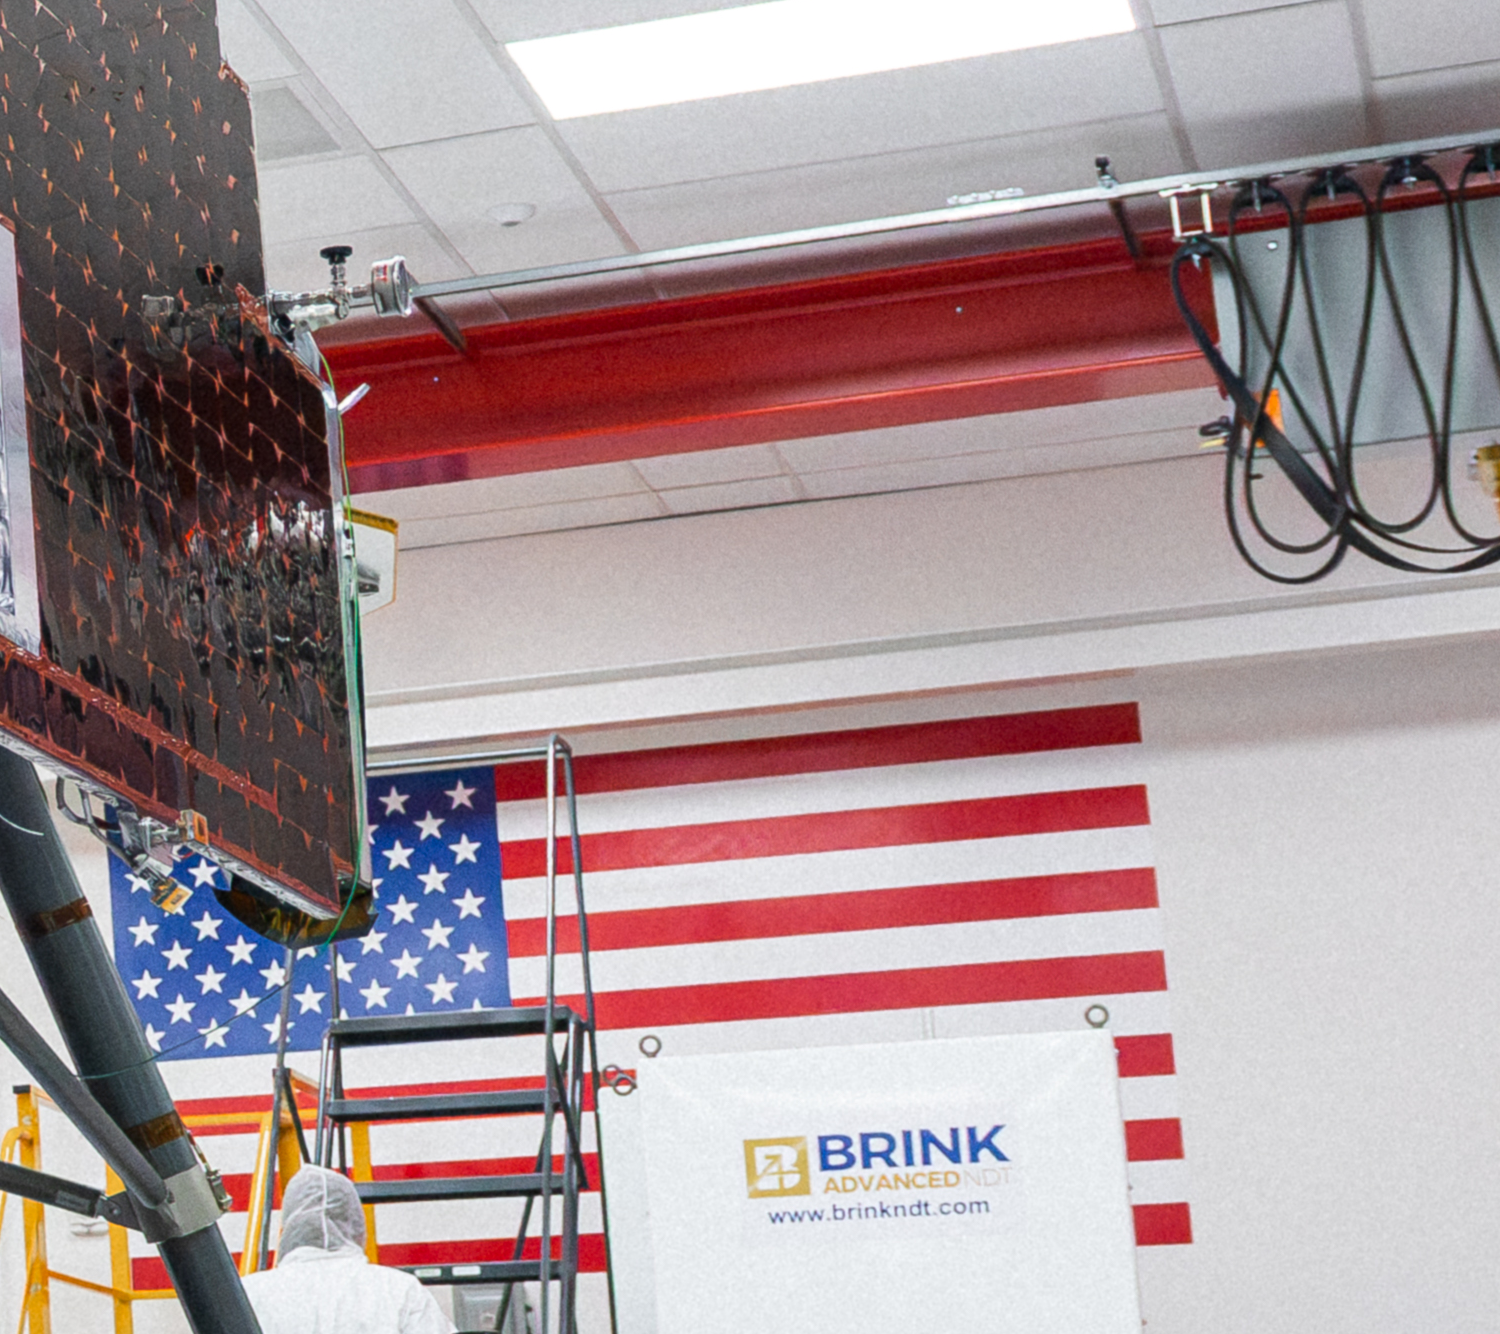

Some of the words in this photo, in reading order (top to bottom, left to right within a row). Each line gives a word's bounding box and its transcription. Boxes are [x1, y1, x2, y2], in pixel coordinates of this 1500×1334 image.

[817, 1124, 1011, 1172] BRINK
[823, 1170, 961, 1195] ADVANCED
[963, 1166, 1013, 1187] NDT
[767, 1198, 991, 1225] www.brinkndt.com
